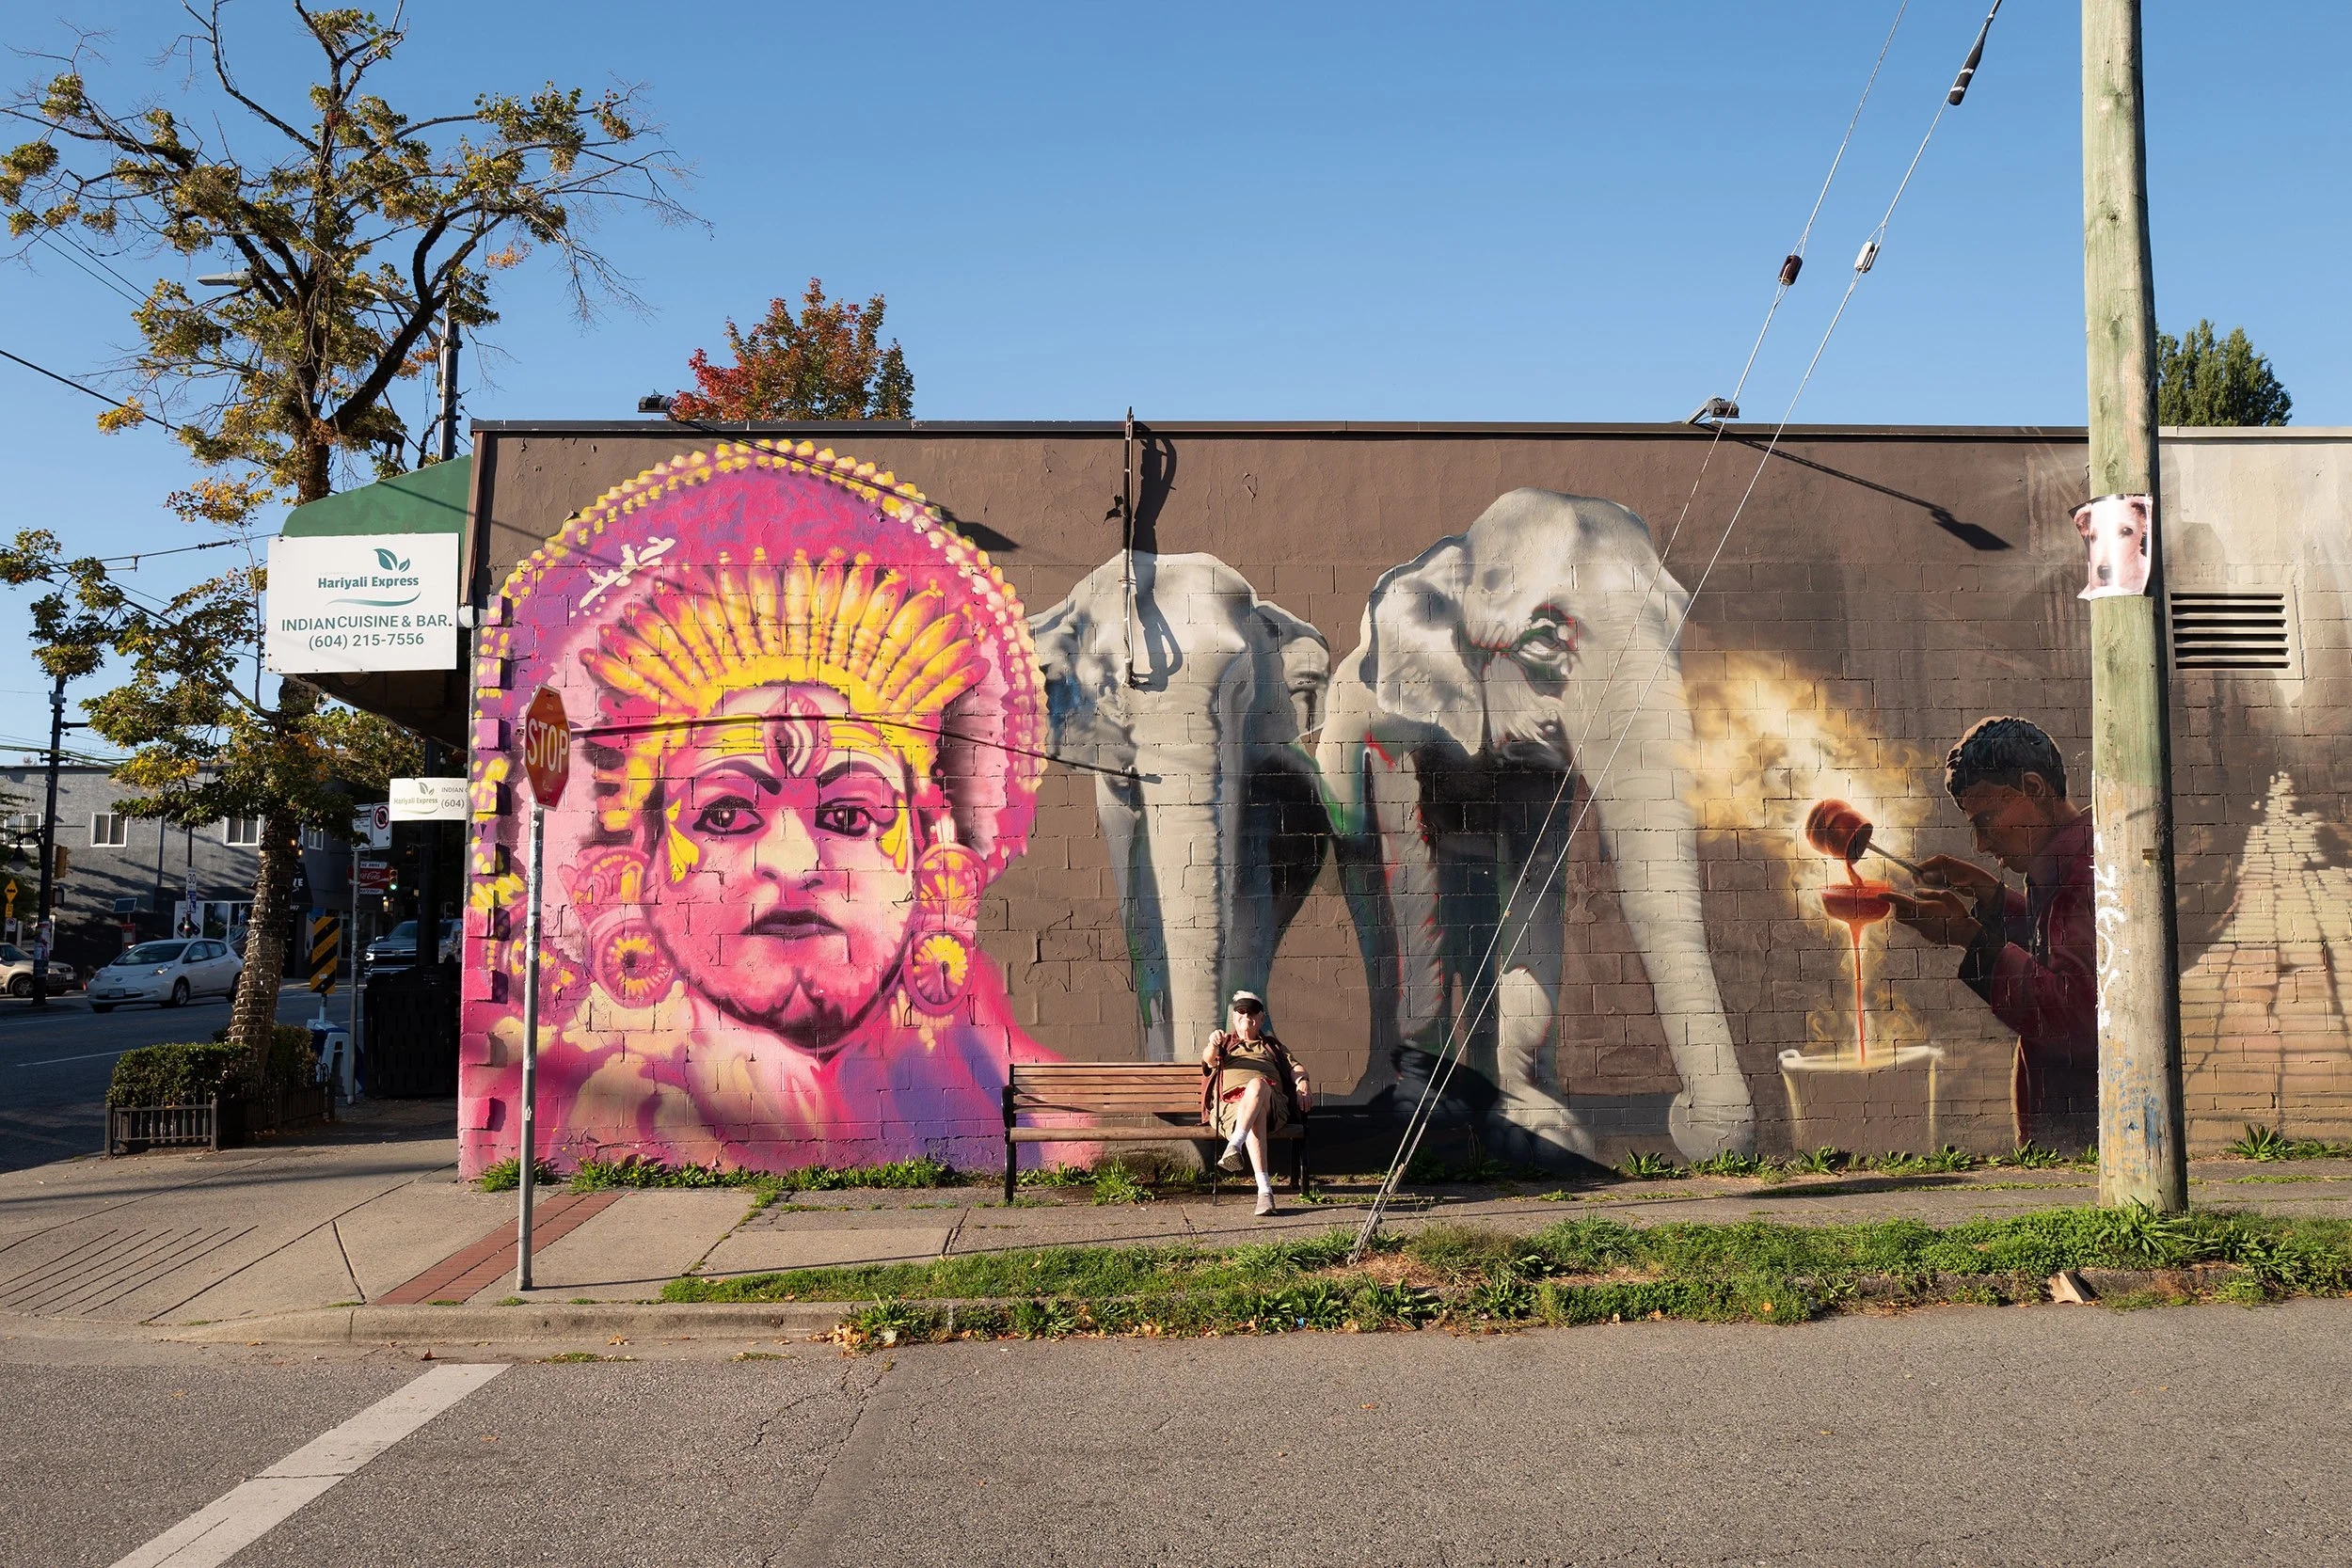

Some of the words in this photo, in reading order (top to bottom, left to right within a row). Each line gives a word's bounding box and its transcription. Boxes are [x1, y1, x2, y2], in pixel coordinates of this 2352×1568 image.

[318, 577, 368, 590] Hariyali
[372, 577, 420, 589] Express
[401, 615, 412, 627] &
[309, 634, 348, 651] (604)
[352, 632, 424, 647] 215-7556
[527, 718, 568, 773] STOP
[416, 797, 438, 805] Express
[441, 799, 465, 809] (604)
[188, 873, 197, 884] 30
